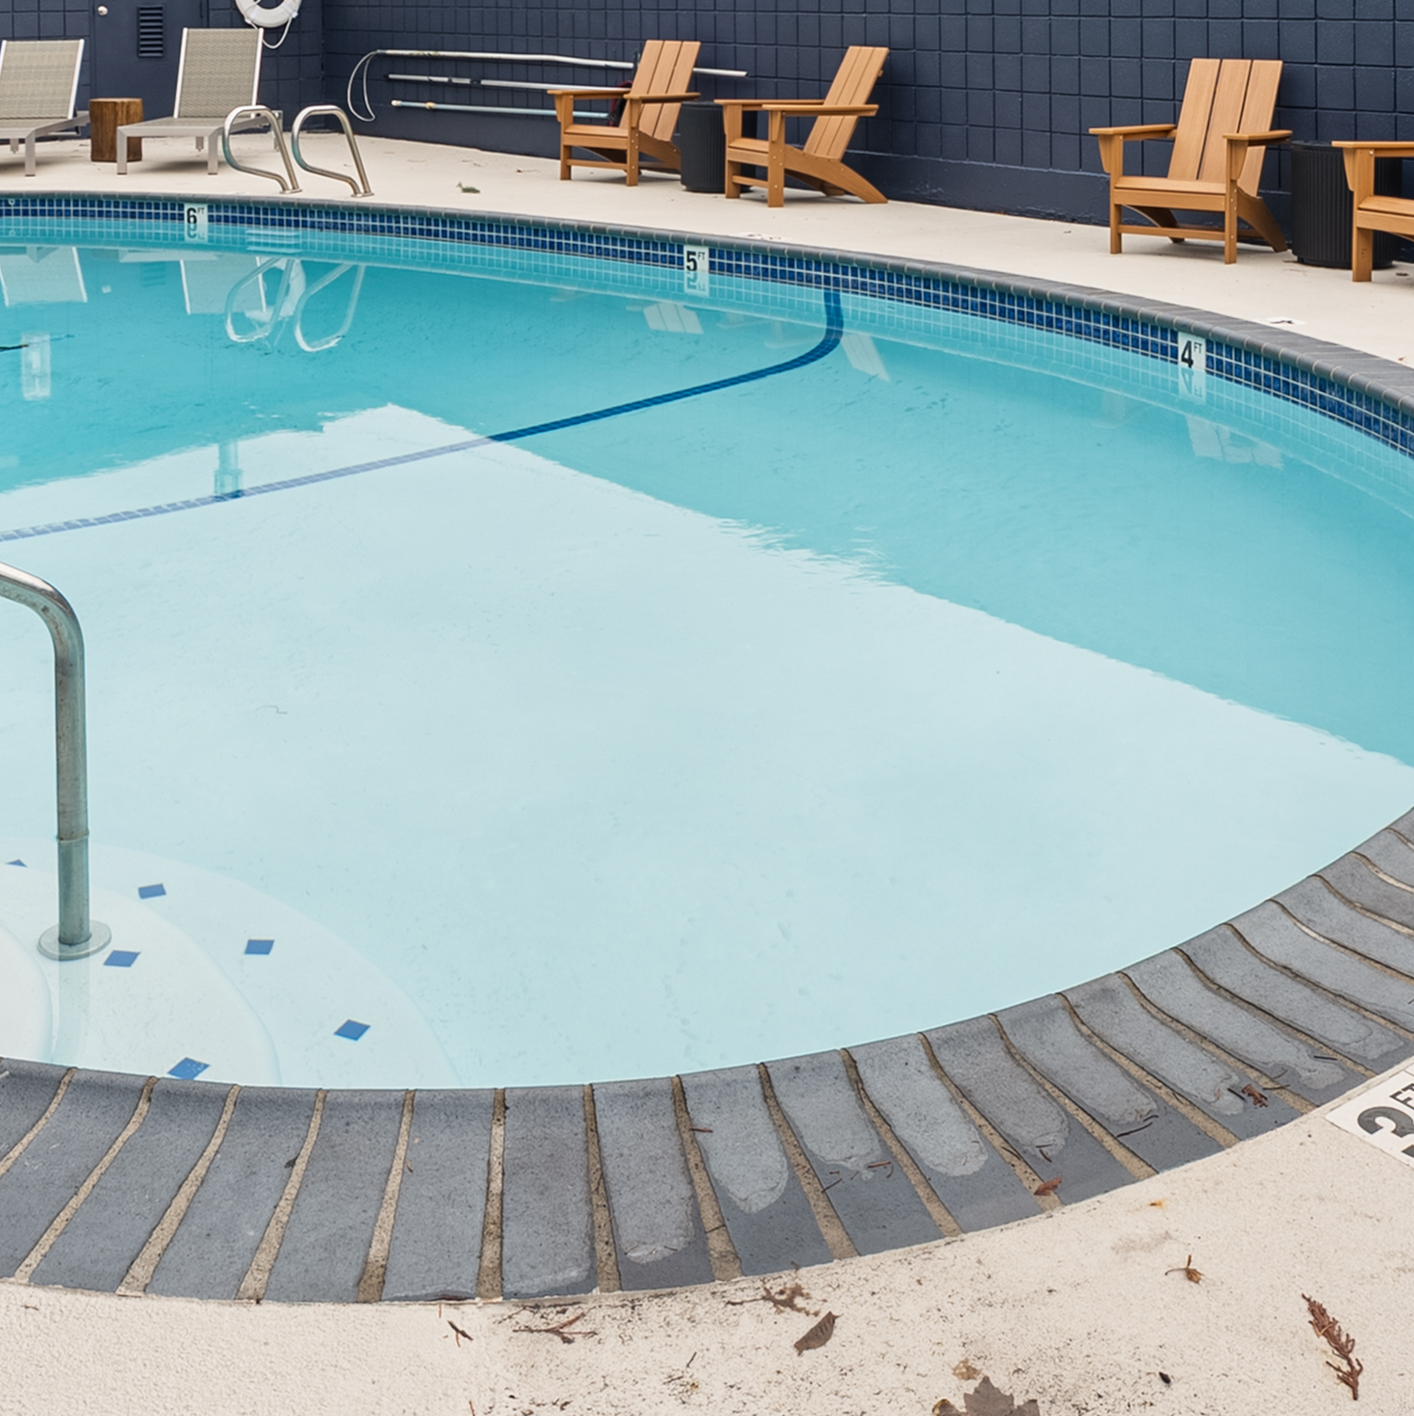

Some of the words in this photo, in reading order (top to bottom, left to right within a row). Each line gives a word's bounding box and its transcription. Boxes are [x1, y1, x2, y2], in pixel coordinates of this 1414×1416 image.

[186, 207, 198, 224] 6
[197, 207, 206, 215] FT
[686, 250, 698, 272] 5
[697, 251, 706, 261] FT
[1181, 340, 1194, 368] 4
[1193, 341, 1203, 355] FT
